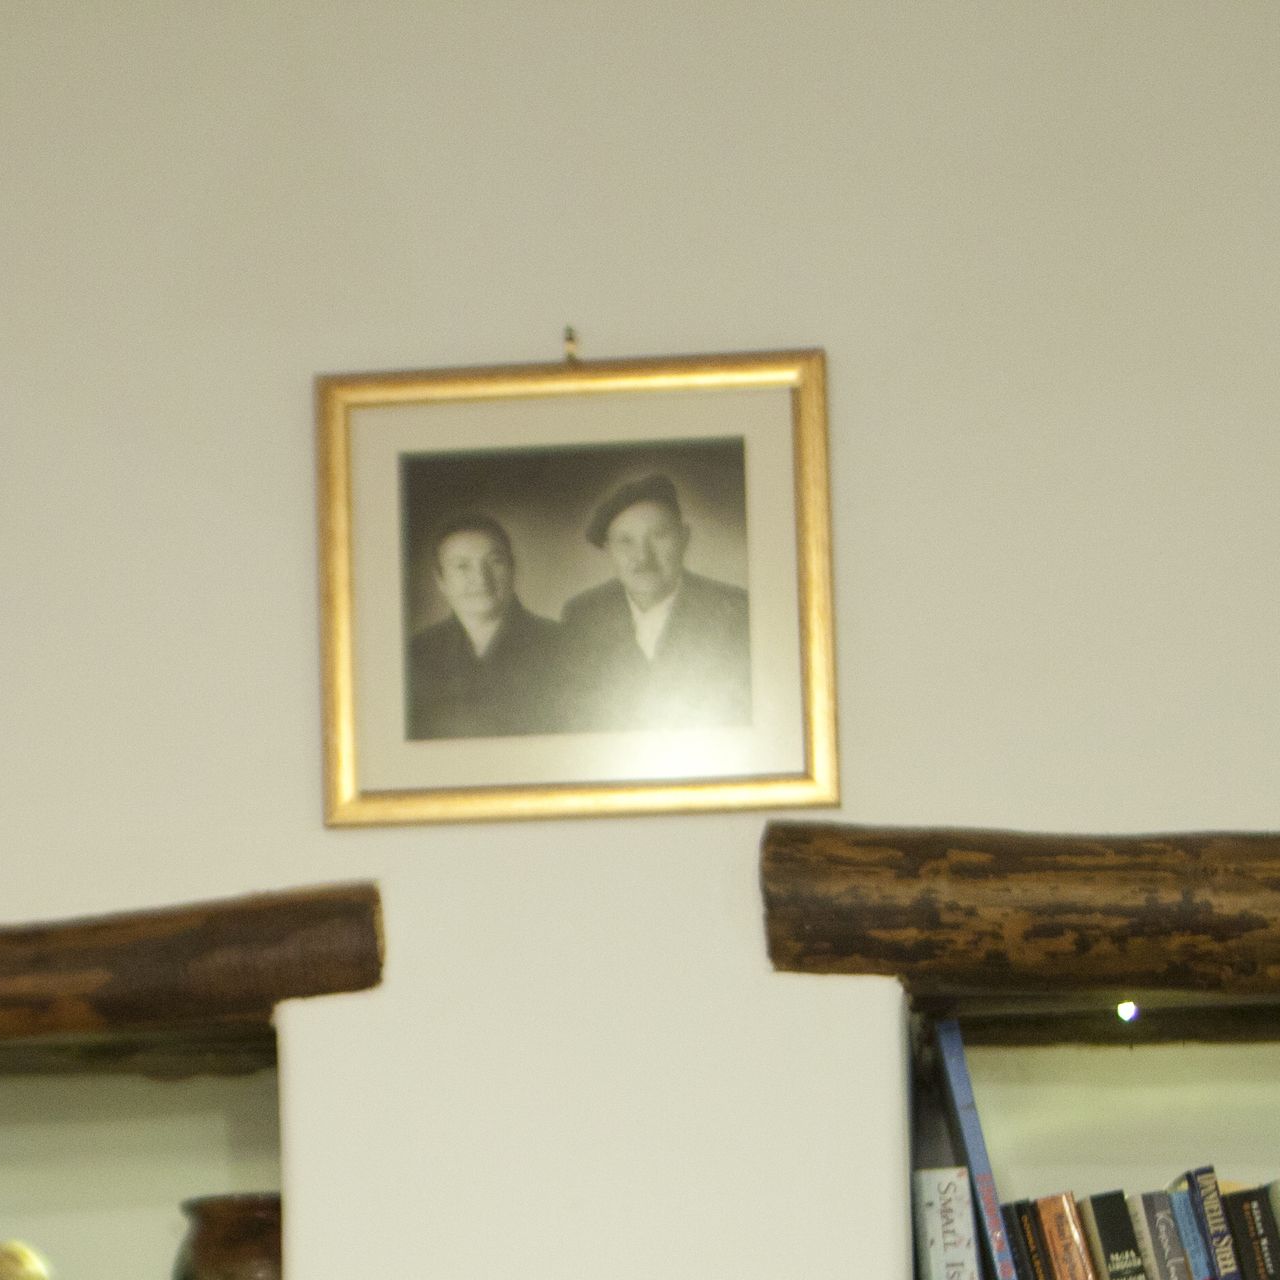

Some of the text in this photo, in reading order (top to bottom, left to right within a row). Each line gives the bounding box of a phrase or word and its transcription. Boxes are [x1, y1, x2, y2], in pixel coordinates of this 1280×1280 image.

[933, 1180, 965, 1252] SMALL
[1194, 1169, 1231, 1236] DANIELLE
[1210, 1232, 1241, 1277] STEEL
